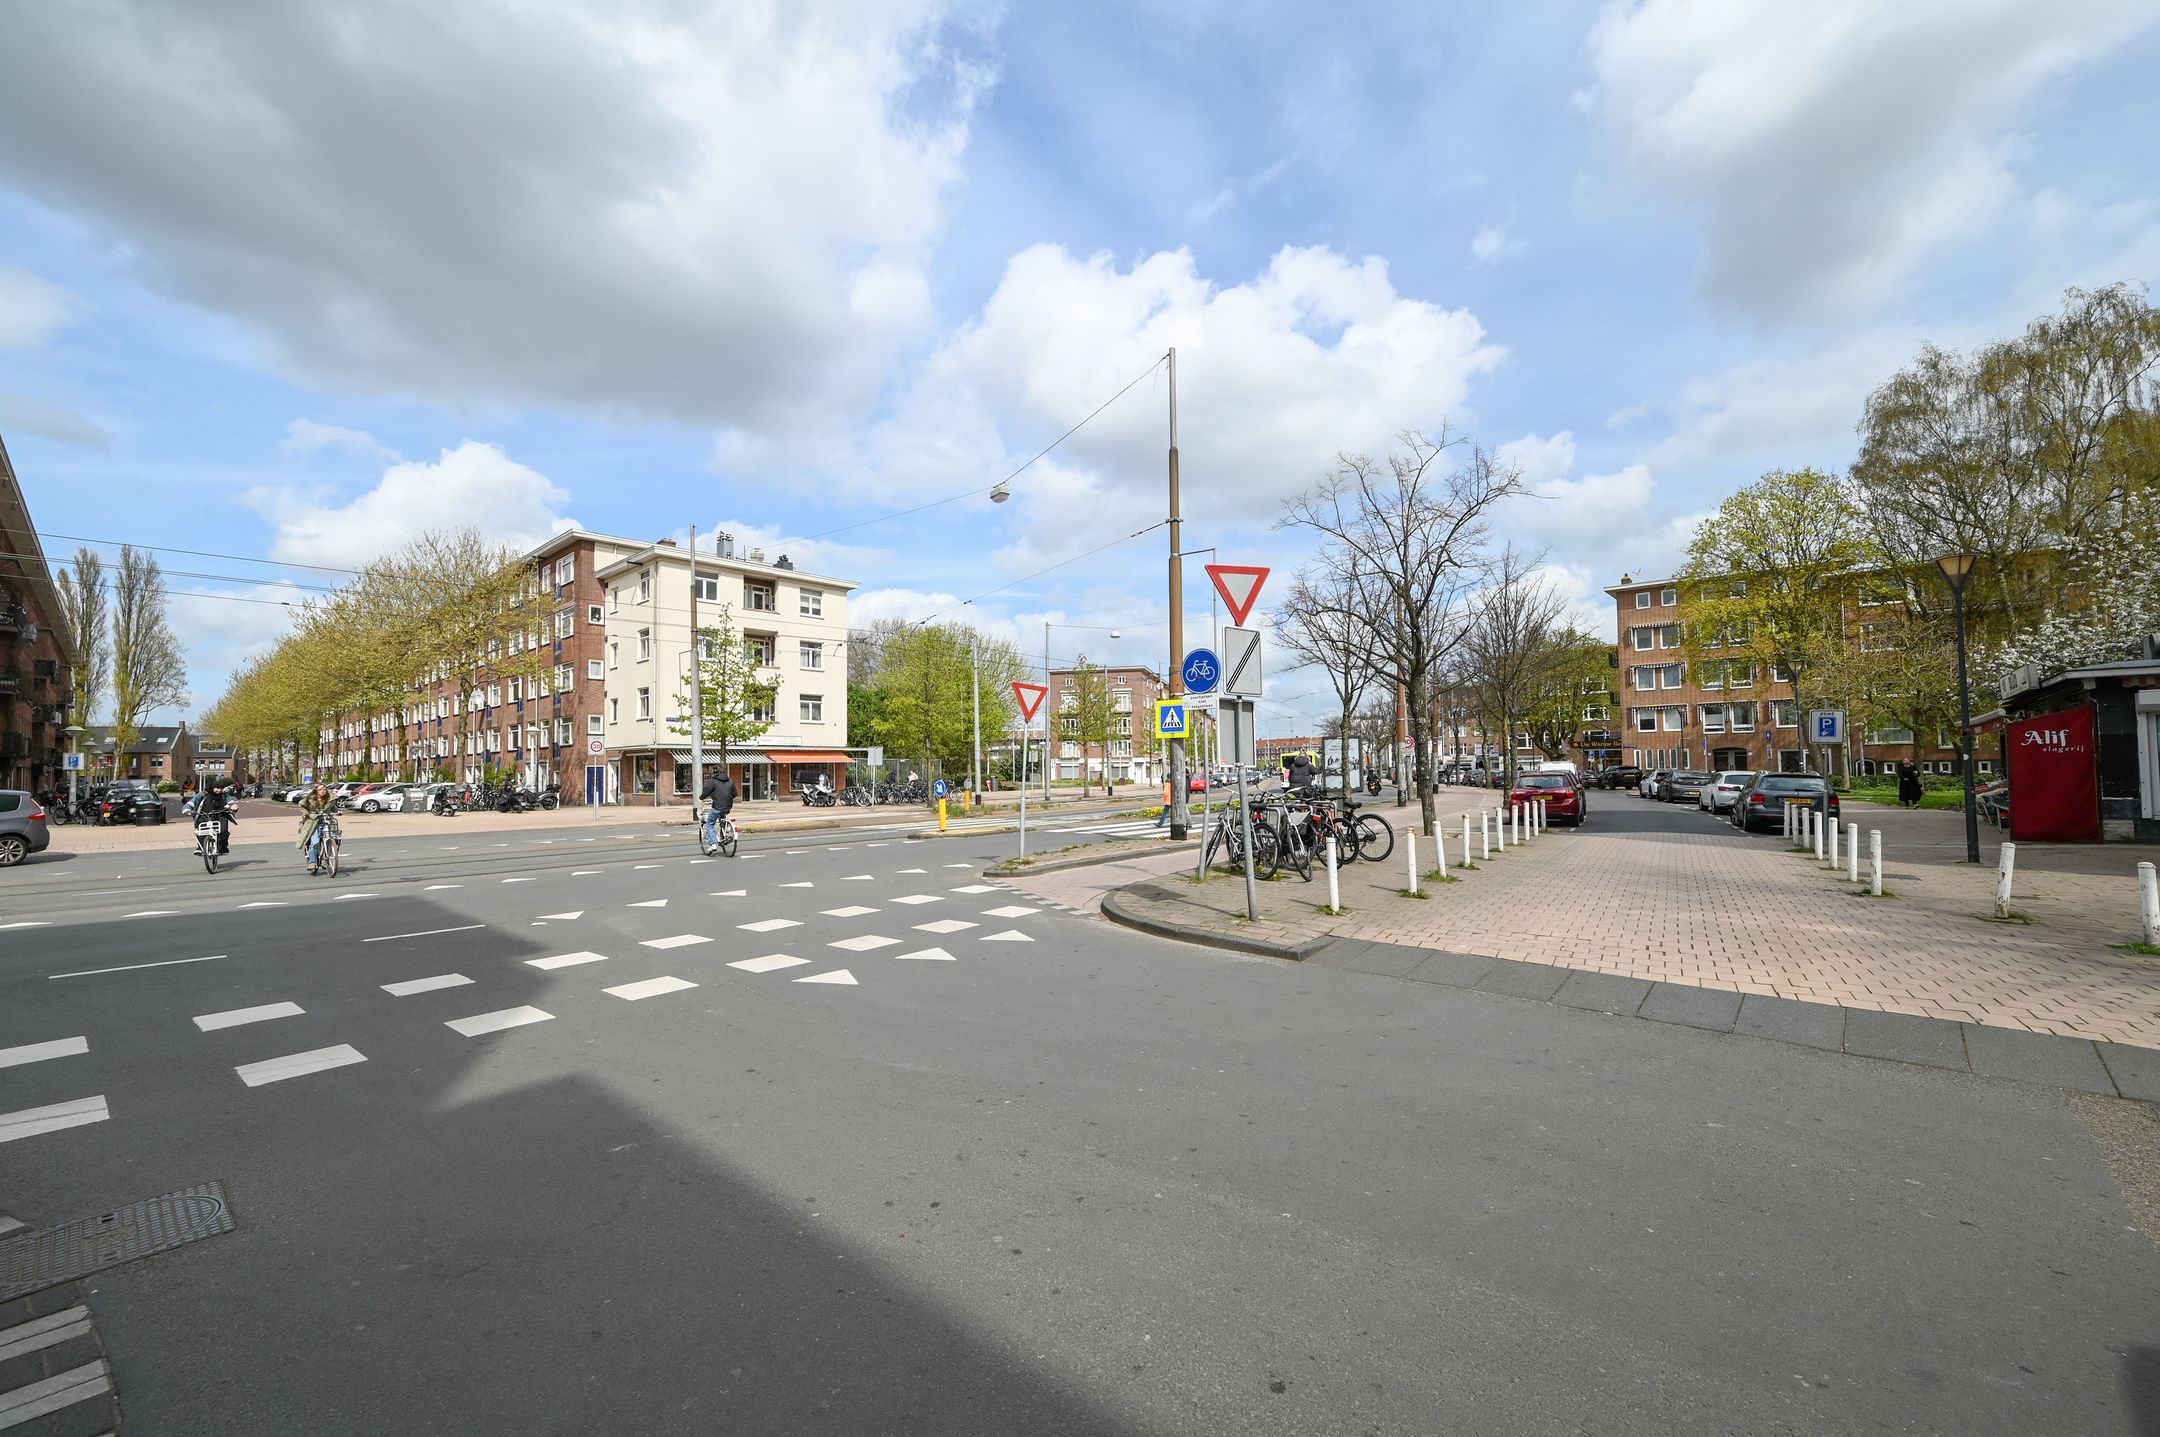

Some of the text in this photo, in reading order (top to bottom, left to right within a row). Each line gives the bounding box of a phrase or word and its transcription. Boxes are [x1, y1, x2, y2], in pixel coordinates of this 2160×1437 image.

[1822, 718, 1832, 729] P
[2020, 729, 2069, 747] Alif
[2042, 745, 2084, 753] slagerij
